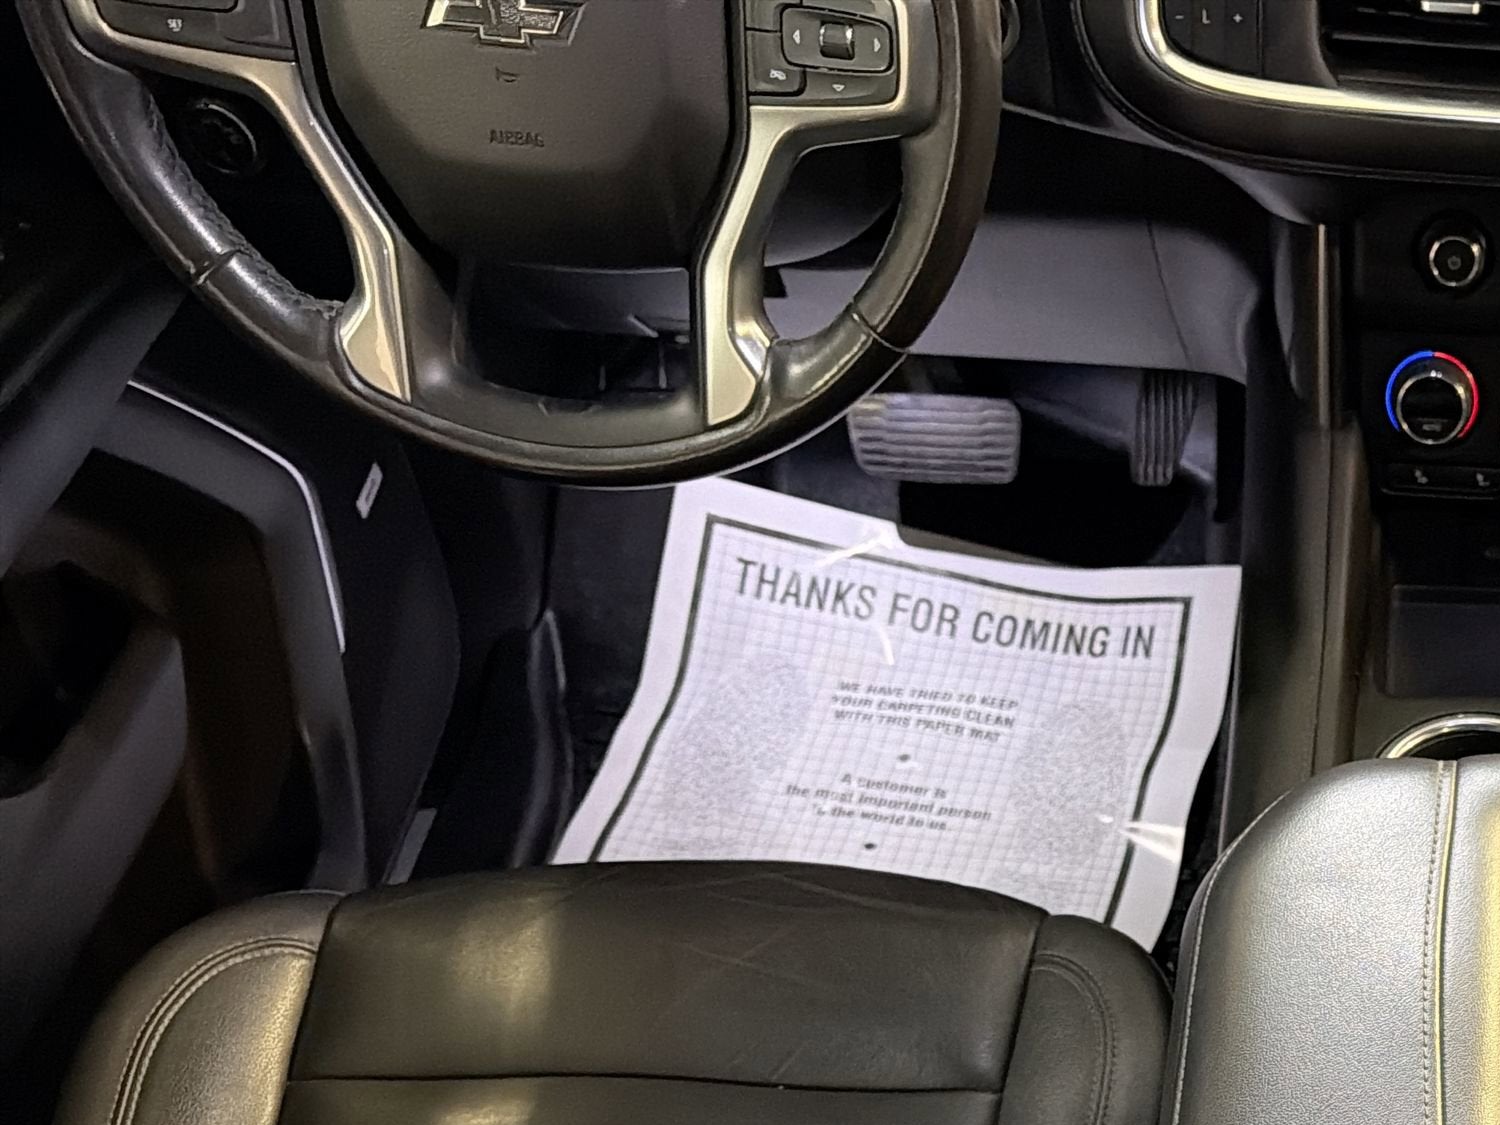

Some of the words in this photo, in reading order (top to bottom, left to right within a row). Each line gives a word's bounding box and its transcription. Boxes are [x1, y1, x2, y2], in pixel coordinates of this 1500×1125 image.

[1202, 8, 1211, 24] L
[737, 557, 877, 620] THANKS
[888, 592, 960, 638] FOR
[972, 611, 1110, 657] COMING
[1121, 625, 1155, 659] IN
[840, 682, 860, 693] WE
[866, 684, 904, 698] HAVE
[909, 687, 952, 703] TRIED
[956, 693, 975, 705] TO
[980, 696, 1019, 710] KEEP
[832, 695, 872, 708] YOUR
[878, 699, 960, 719] CARPETING
[963, 708, 1015, 728] CLEAN
[835, 710, 873, 723] WITH
[877, 715, 912, 728] THIS
[916, 719, 964, 736] PAPER
[969, 728, 1001, 742] MAT
[841, 774, 852, 785] A
[857, 777, 928, 797] customer
[787, 784, 809, 797] the
[859, 793, 935, 814] important
[937, 806, 993, 823] person
[831, 806, 854, 818] the
[860, 811, 905, 825] world
[907, 815, 924, 828] to
